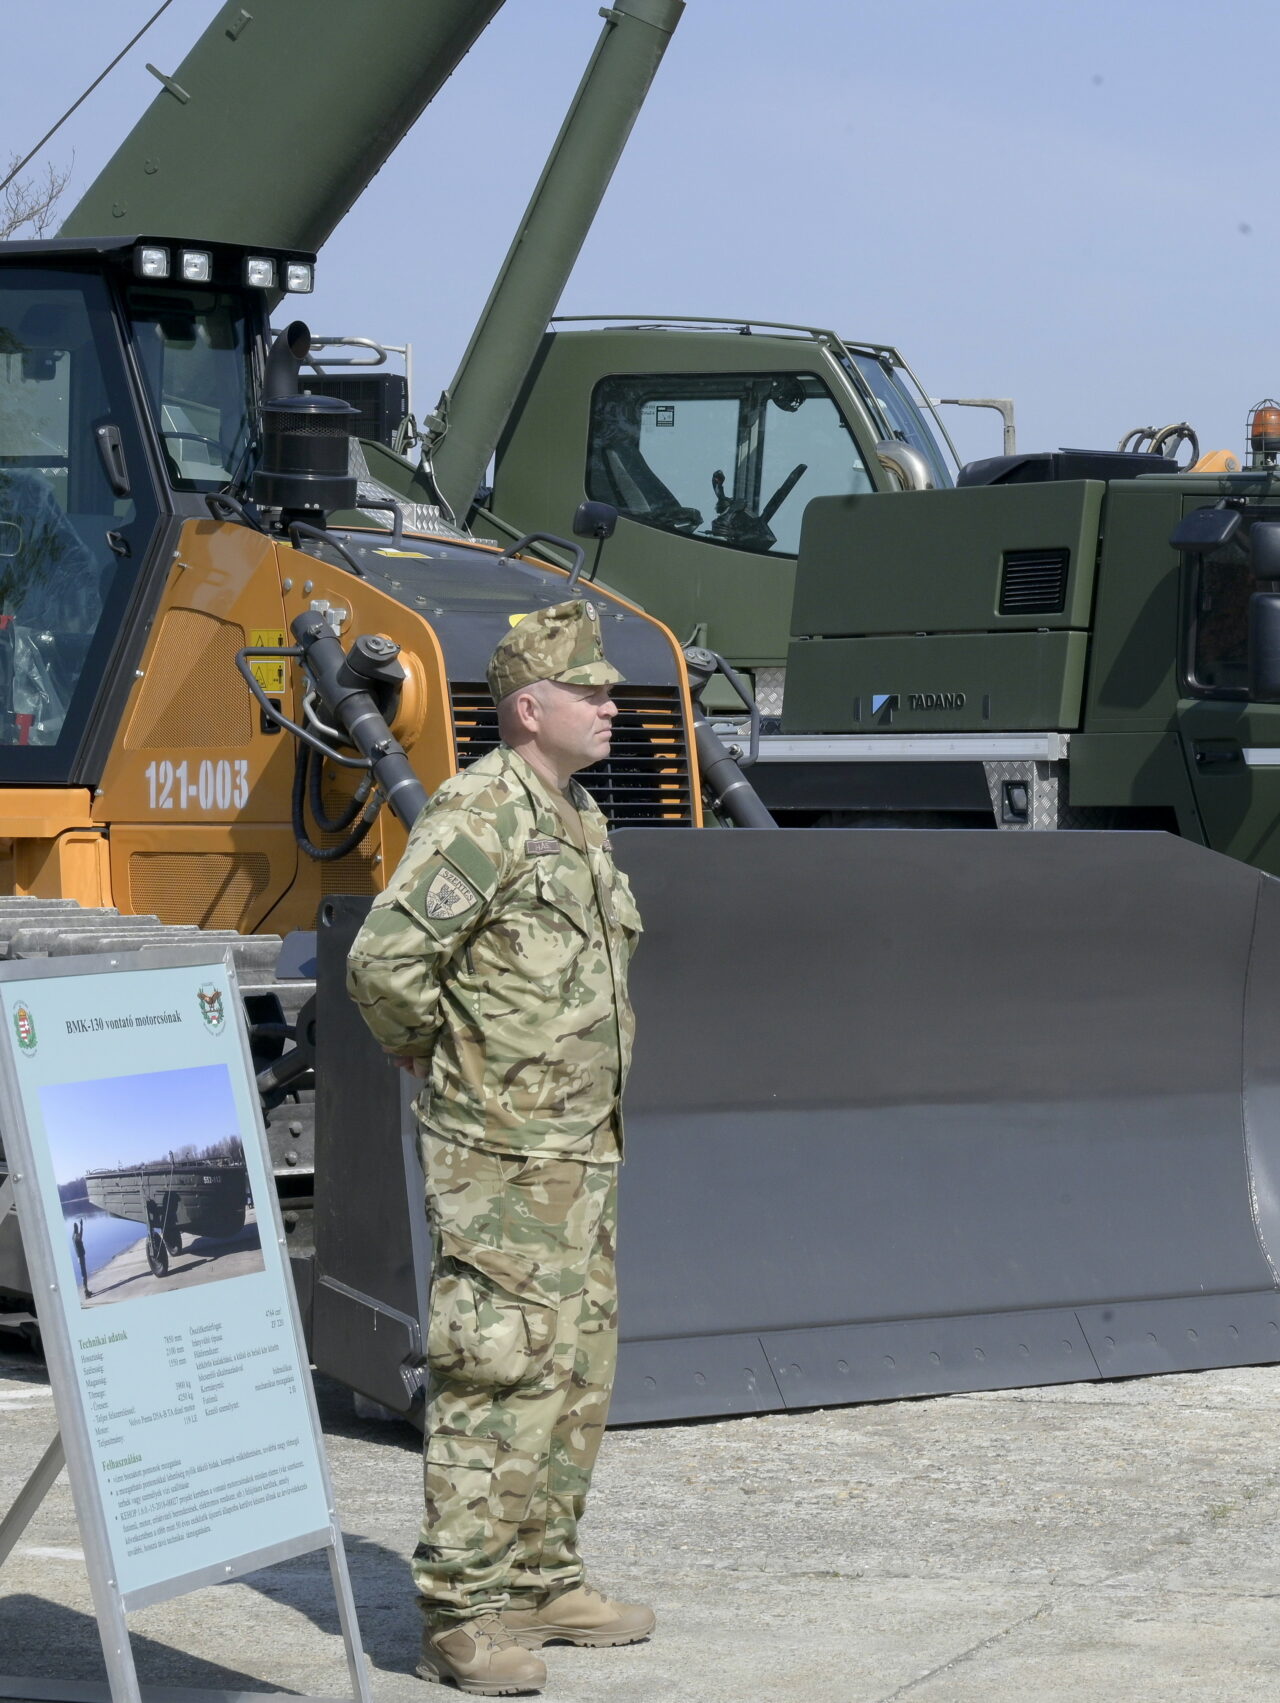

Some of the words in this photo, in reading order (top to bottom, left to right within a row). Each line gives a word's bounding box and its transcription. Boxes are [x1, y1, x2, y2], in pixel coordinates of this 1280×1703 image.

[907, 692, 966, 711] TADANO
[144, 759, 250, 811] 121-003
[442, 868, 475, 905] SZENTES
[65, 1018, 104, 1034] BMK-130
[105, 1015, 133, 1029] vontató
[135, 1010, 182, 1026] motorcsónak
[78, 1334, 107, 1350] Technikai
[108, 1330, 128, 1343] adatok
[102, 1454, 142, 1472] Felhasználása
